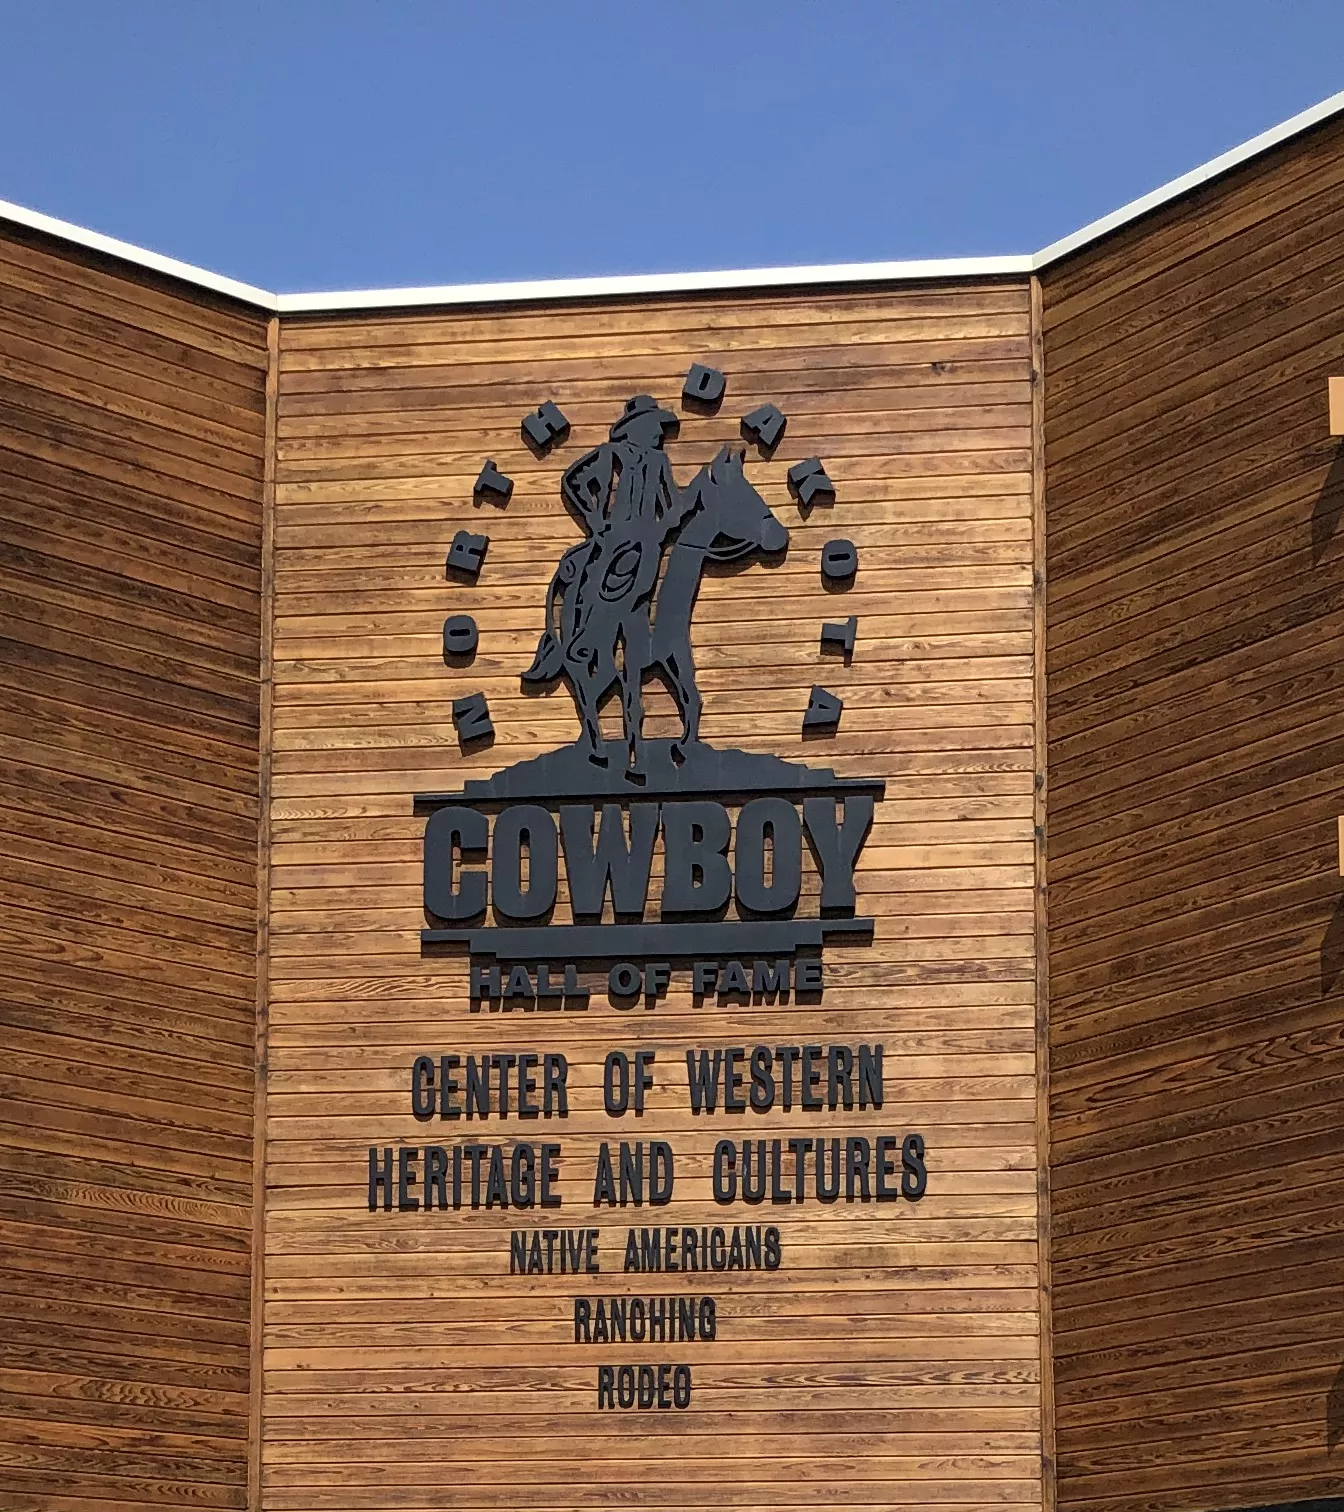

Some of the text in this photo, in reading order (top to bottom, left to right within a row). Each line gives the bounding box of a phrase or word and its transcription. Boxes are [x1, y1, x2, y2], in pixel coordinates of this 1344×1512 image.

[442, 362, 858, 754] NORTH DAKOTA
[423, 796, 875, 922] COWBOY
[470, 958, 824, 1005] HALL OF FAME
[411, 1044, 885, 1121] CENTER OF WESTERN
[367, 1133, 928, 1212] HERITAGE AND CULTURES
[510, 1225, 782, 1274] NATIVE AMERICANS
[574, 1296, 717, 1343] RANCHING
[597, 1364, 692, 1410] RODEO
